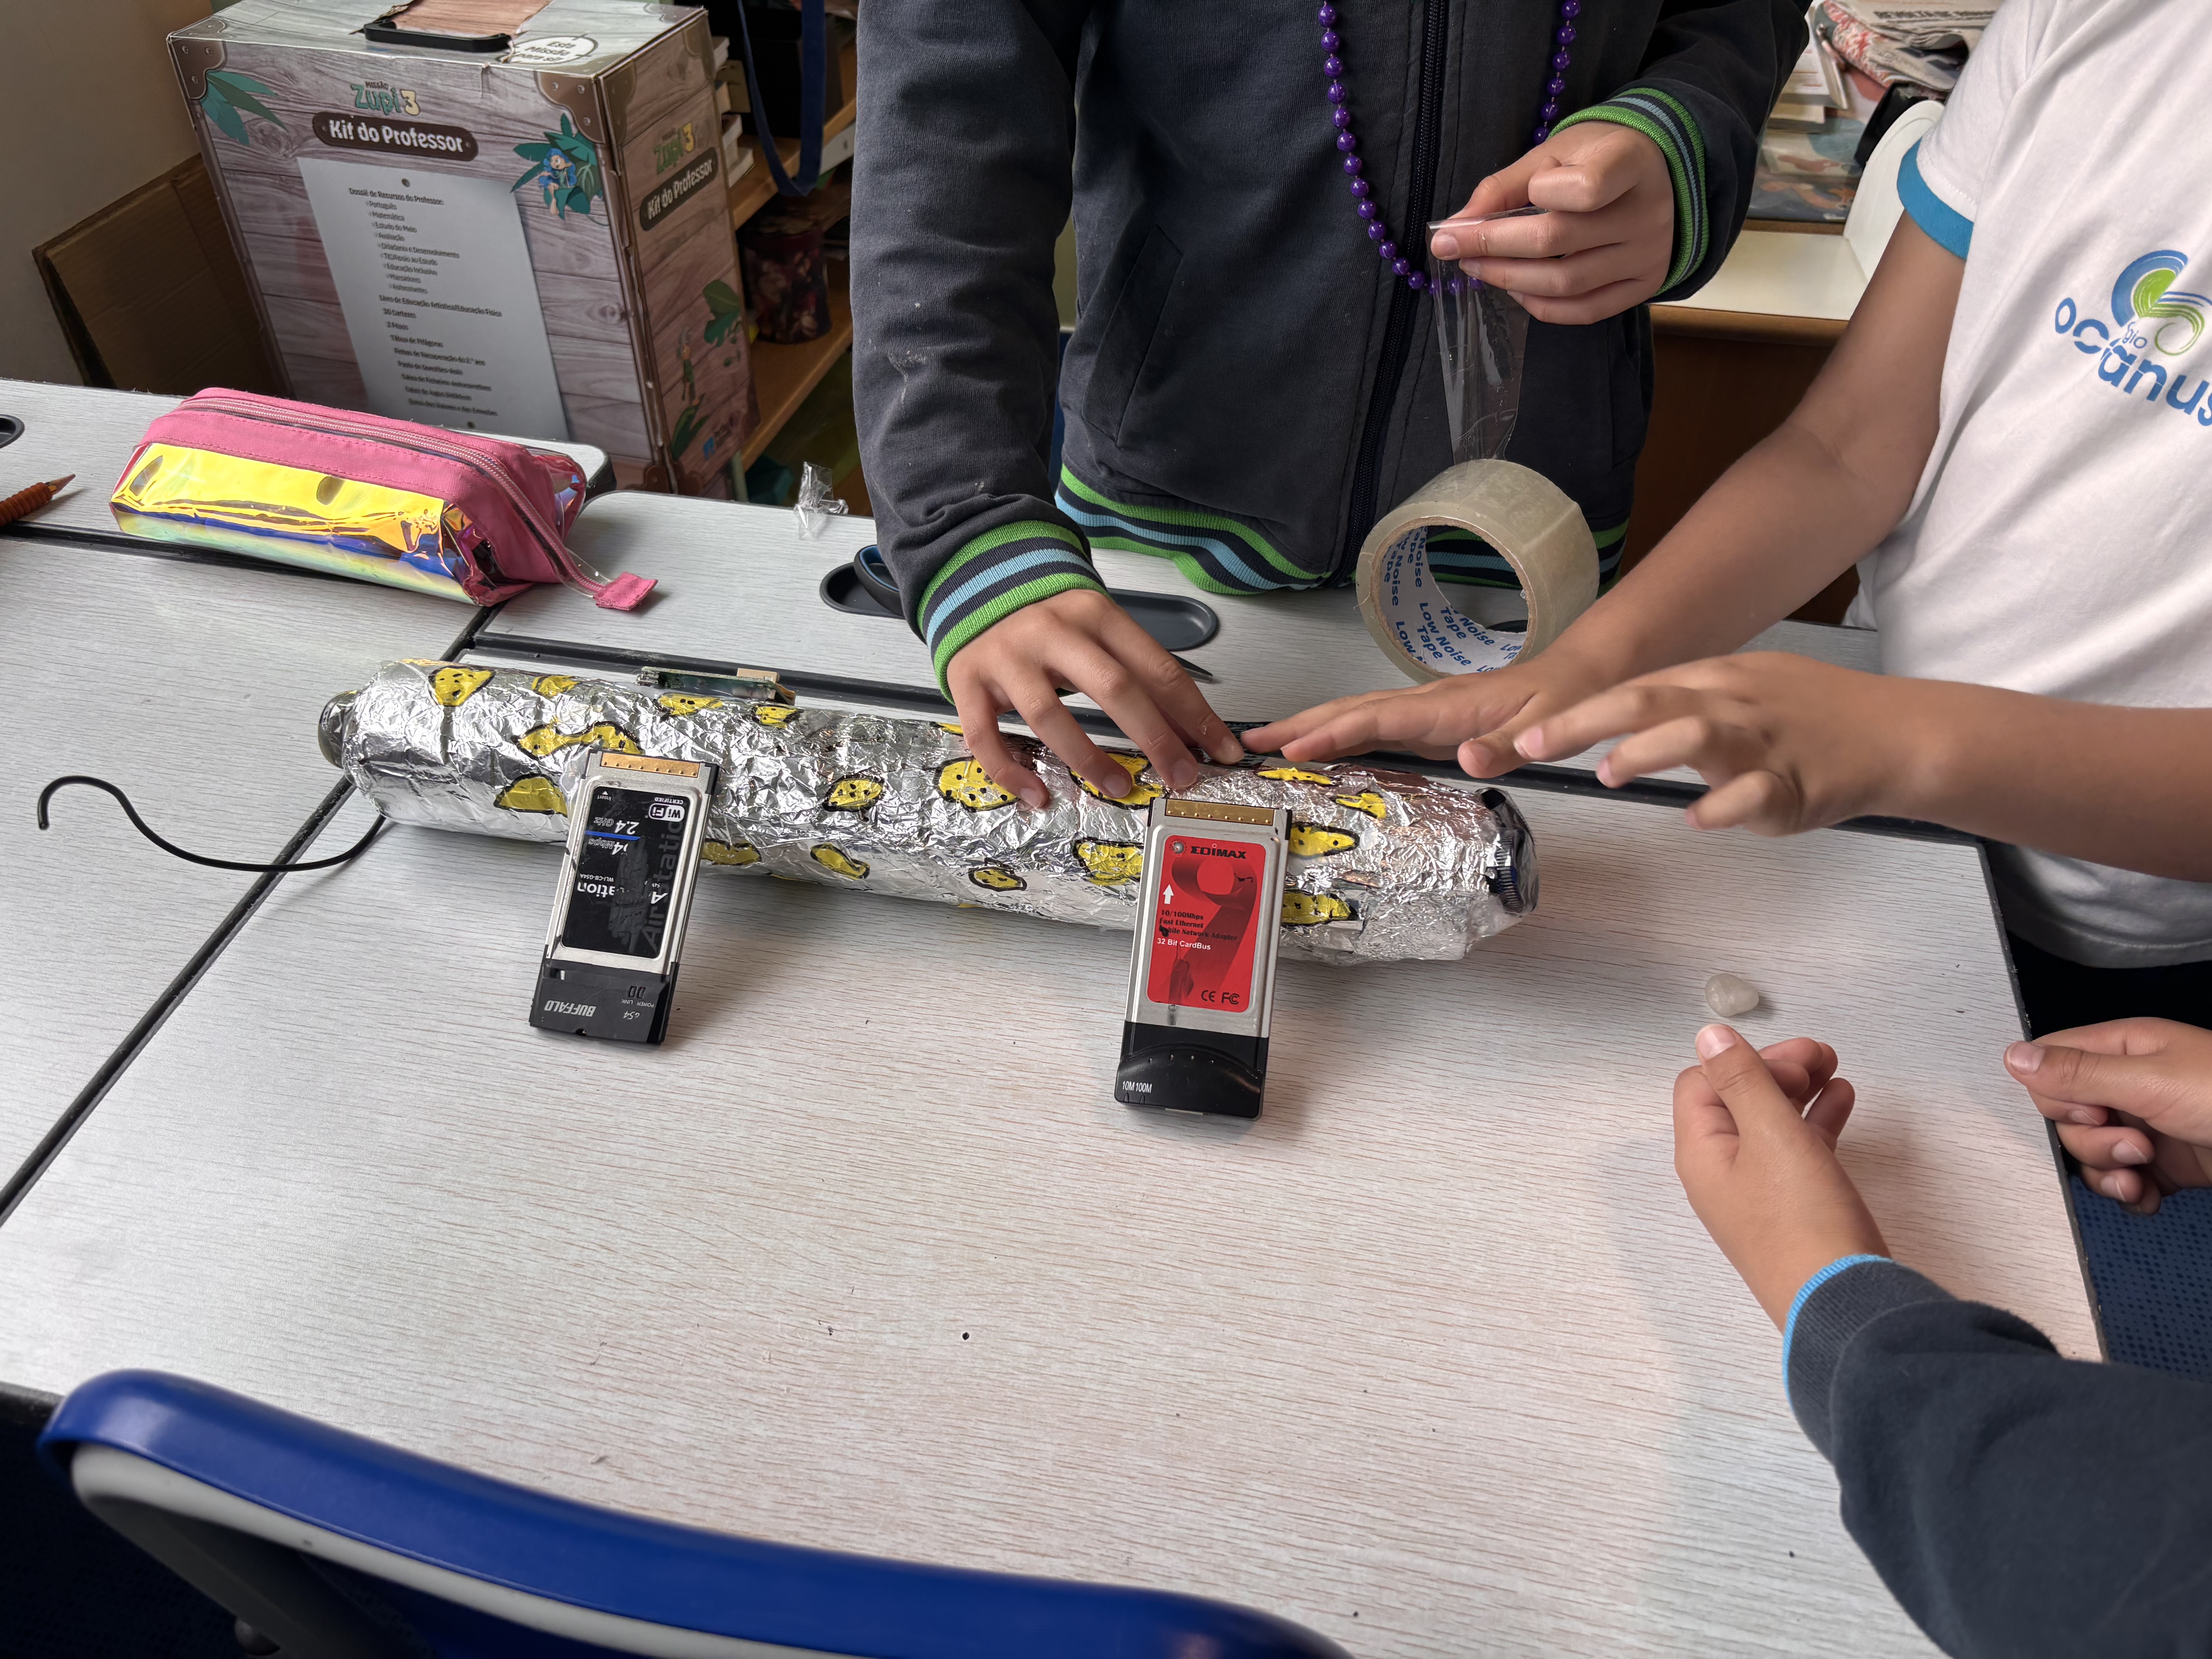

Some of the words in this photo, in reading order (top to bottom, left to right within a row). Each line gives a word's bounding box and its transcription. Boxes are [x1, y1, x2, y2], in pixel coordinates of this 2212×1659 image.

[350, 84, 402, 116] Zupi
[400, 89, 421, 116] 3
[329, 119, 354, 140] Kit
[357, 122, 380, 143] do
[381, 125, 463, 153] Professor
[683, 121, 694, 153] 3
[647, 194, 661, 220] Kit
[661, 189, 673, 208] do
[673, 159, 713, 199] Professor
[1415, 538, 1426, 587] Noise
[1392, 555, 1403, 606] Noise
[1396, 621, 1416, 653] Low
[1420, 603, 1439, 634] Low
[1435, 636, 1472, 666] Noise
[1441, 606, 1466, 639] Tape
[1459, 617, 1495, 645] Noise
[1417, 625, 1443, 659] Tape
[593, 817, 614, 827] GHz
[615, 820, 640, 835] 2.4
[1190, 844, 1247, 859] EDIMAX
[580, 873, 614, 882] WLI-CB-G54A
[642, 820, 683, 953] AirStatio
[1161, 910, 1204, 920] 10/100Mbps
[1176, 919, 1203, 928] Ethernet
[1163, 926, 1180, 934] bile
[1182, 929, 1209, 938] Network
[1211, 933, 1238, 941] Adapter
[1180, 941, 1211, 950] CardBus
[544, 1000, 596, 1017] BUFFALO
[1123, 1080, 1135, 1091] 10M
[1135, 1082, 1152, 1093] 100M
